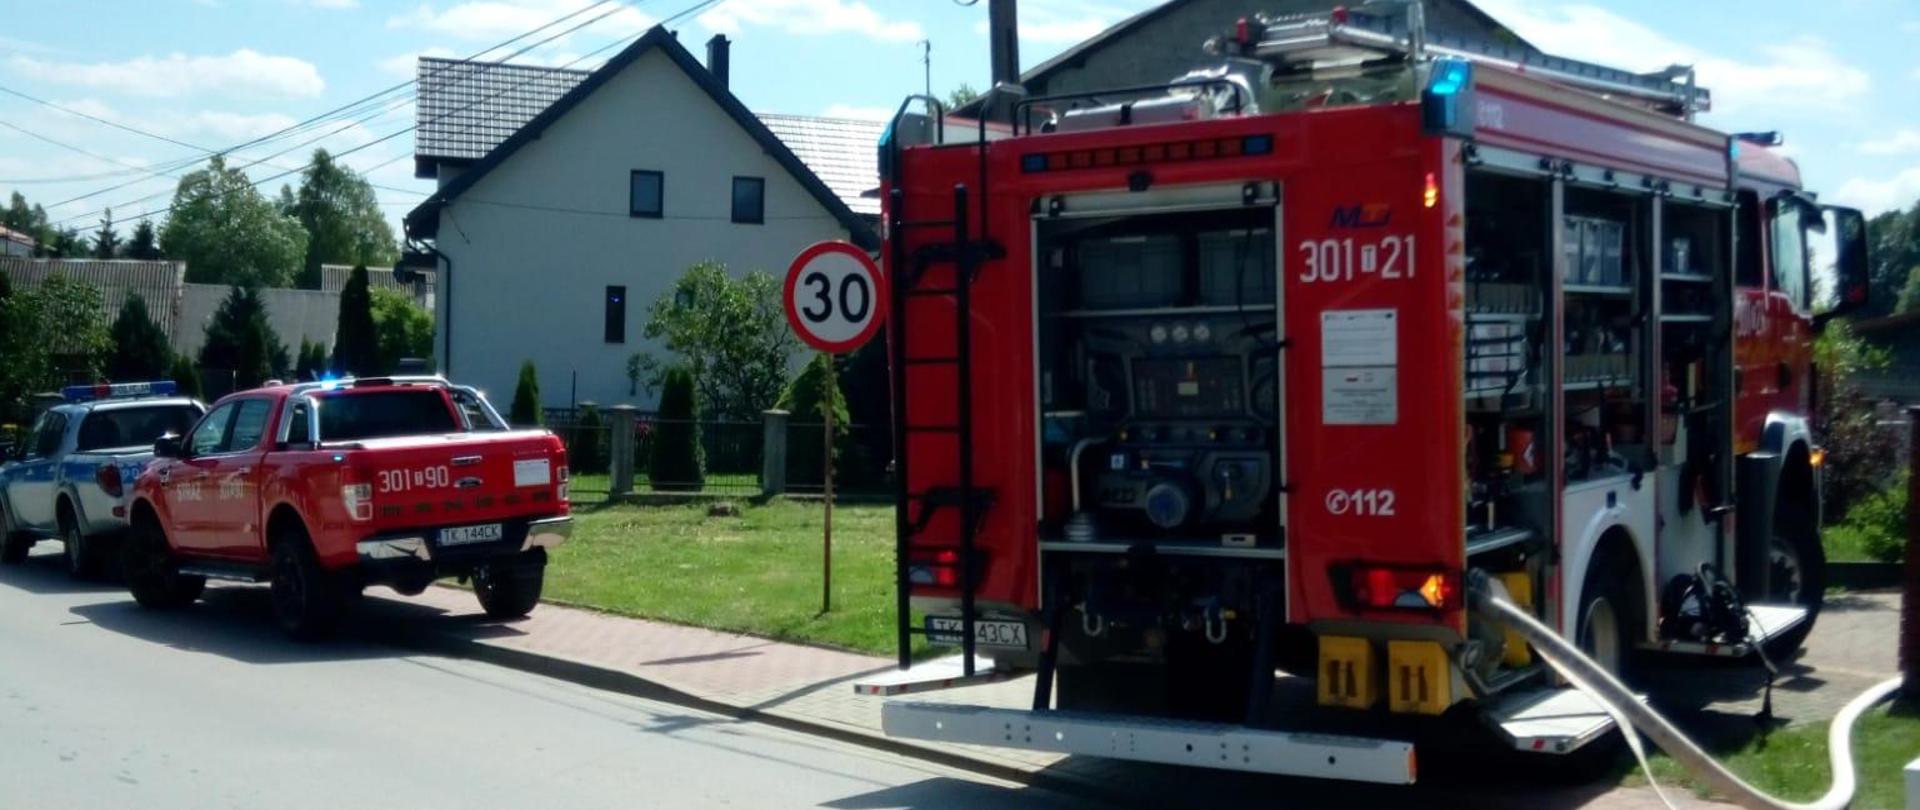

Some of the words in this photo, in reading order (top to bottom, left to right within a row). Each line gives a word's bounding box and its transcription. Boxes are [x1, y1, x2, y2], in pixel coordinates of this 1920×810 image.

[1299, 238, 1353, 283] 301
[1380, 234, 1415, 279] 21
[802, 271, 870, 324] 30
[378, 468, 411, 493] 301
[424, 464, 449, 488] 90
[1351, 488, 1395, 516] 112
[971, 623, 1021, 645] 43CX
